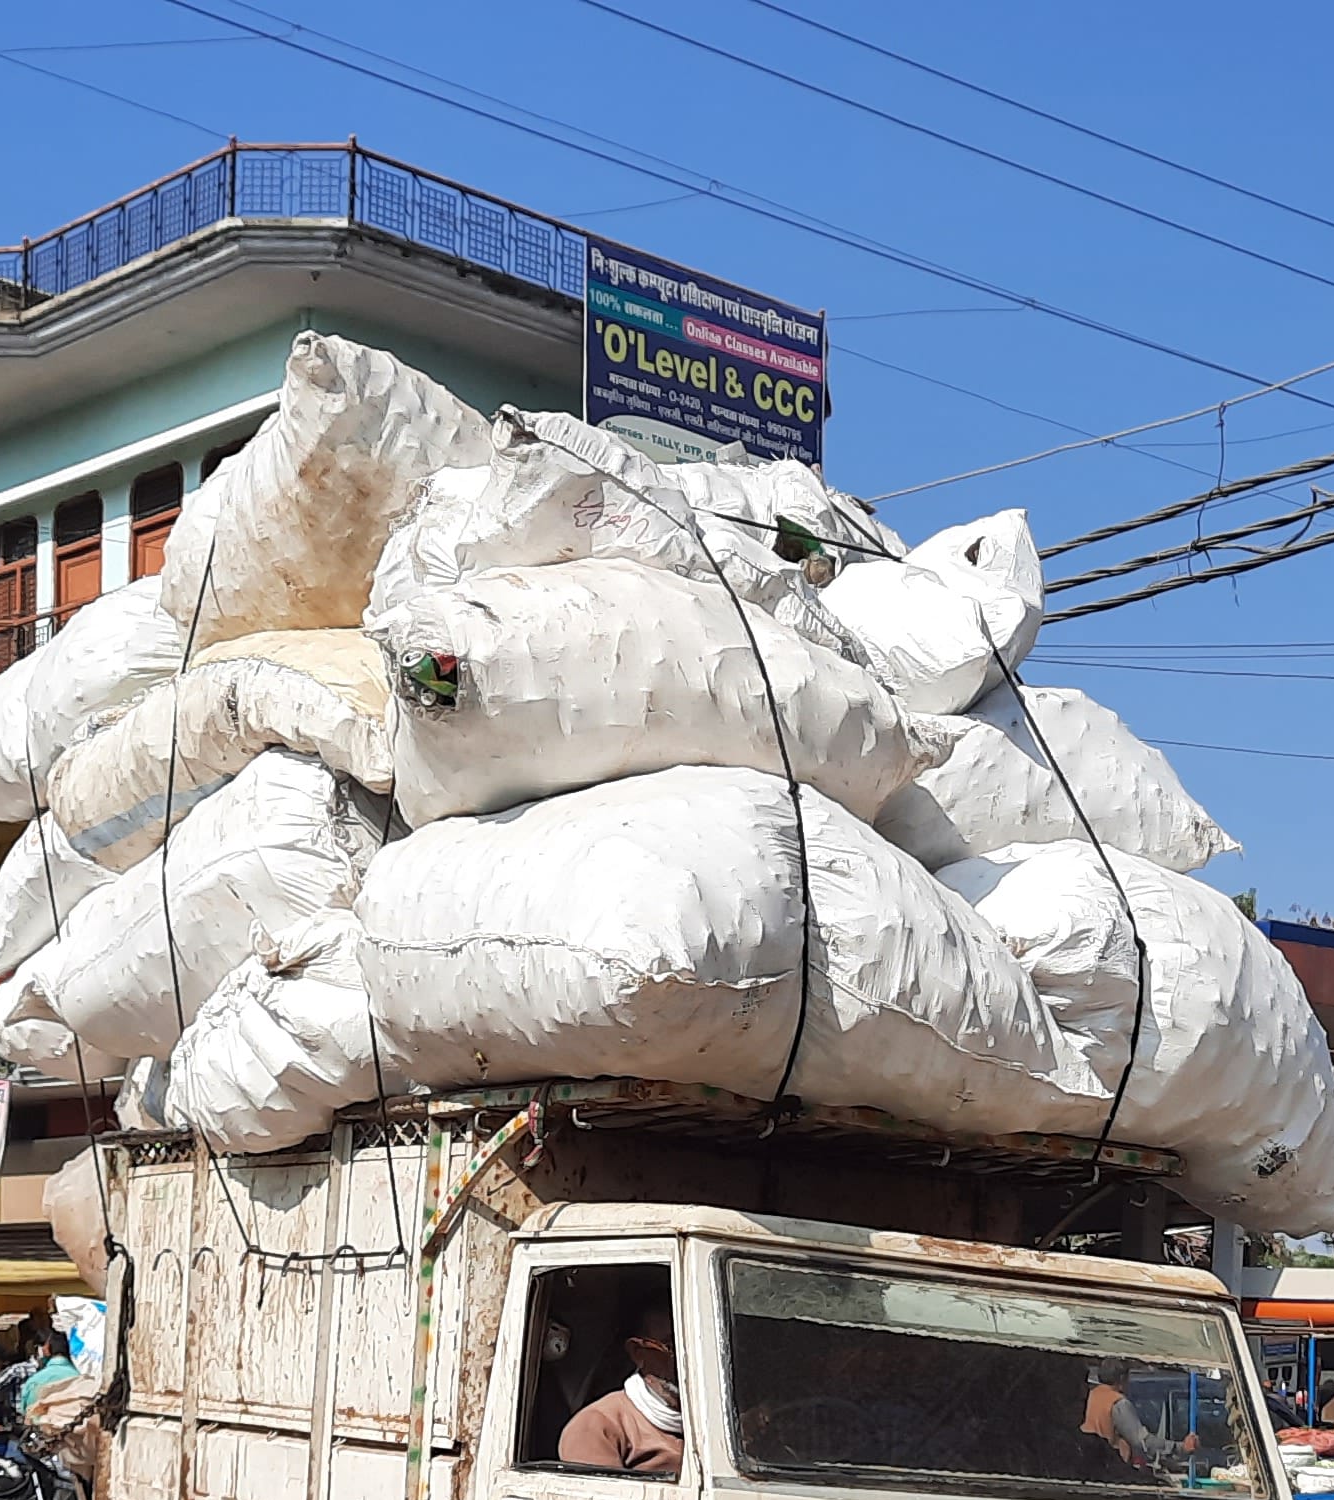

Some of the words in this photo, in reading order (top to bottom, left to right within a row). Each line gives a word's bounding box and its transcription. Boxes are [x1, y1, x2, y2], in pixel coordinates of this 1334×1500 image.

[589, 288, 621, 313] 100%
[724, 297, 740, 321] एवं
[687, 322, 723, 346] Online
[724, 334, 767, 361] Classes
[769, 350, 819, 377] Available
[724, 366, 745, 399] &
[753, 373, 815, 424] CCC
